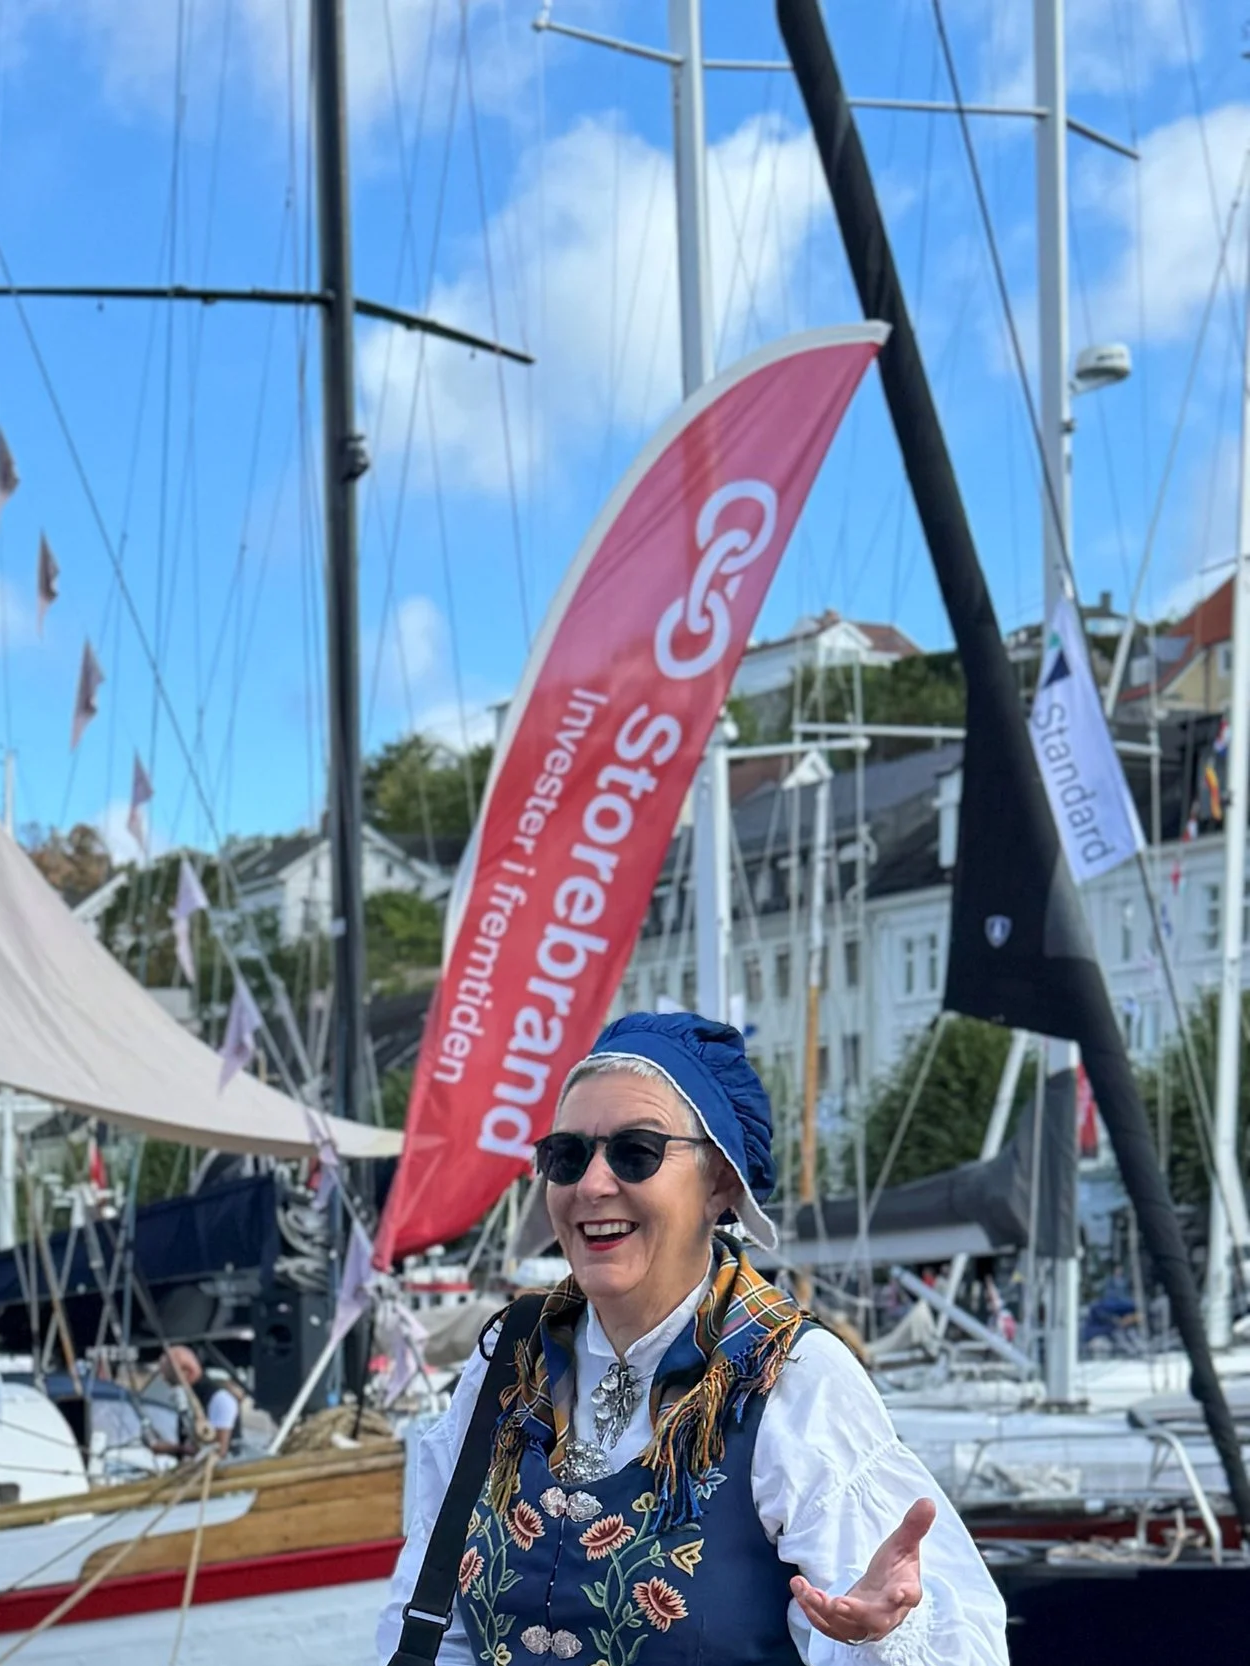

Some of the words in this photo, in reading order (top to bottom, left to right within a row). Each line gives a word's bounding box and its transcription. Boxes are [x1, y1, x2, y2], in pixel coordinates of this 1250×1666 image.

[513, 687, 609, 855] Invester
[1034, 702, 1116, 864] Standard
[478, 704, 682, 1160] Storebrand
[501, 860, 537, 878] i
[433, 882, 528, 1085] fremtiden
